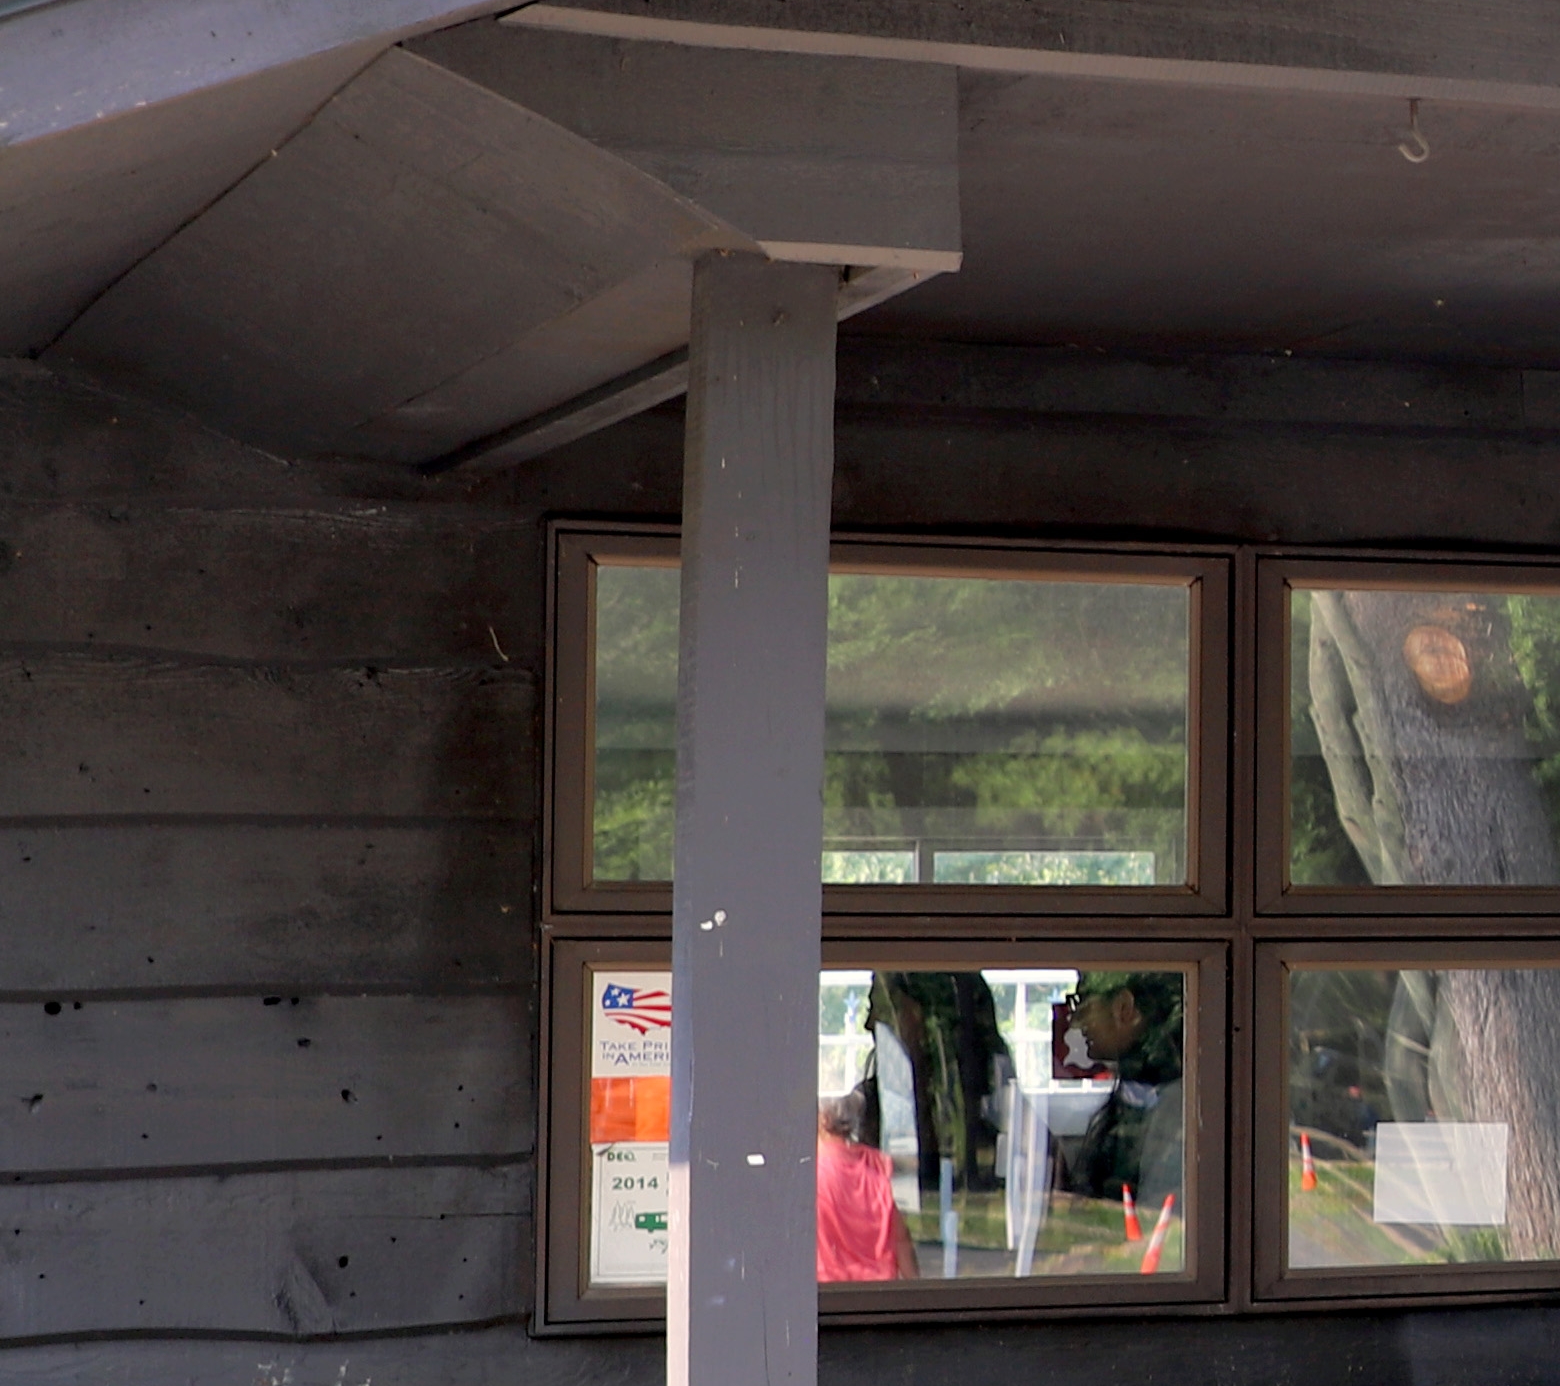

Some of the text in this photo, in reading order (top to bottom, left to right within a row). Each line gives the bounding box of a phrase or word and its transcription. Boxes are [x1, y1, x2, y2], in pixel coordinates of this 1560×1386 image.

[600, 1040, 669, 1051] TAKE PRI
[614, 1052, 670, 1066] AMERI
[612, 1176, 659, 1190] 2014
